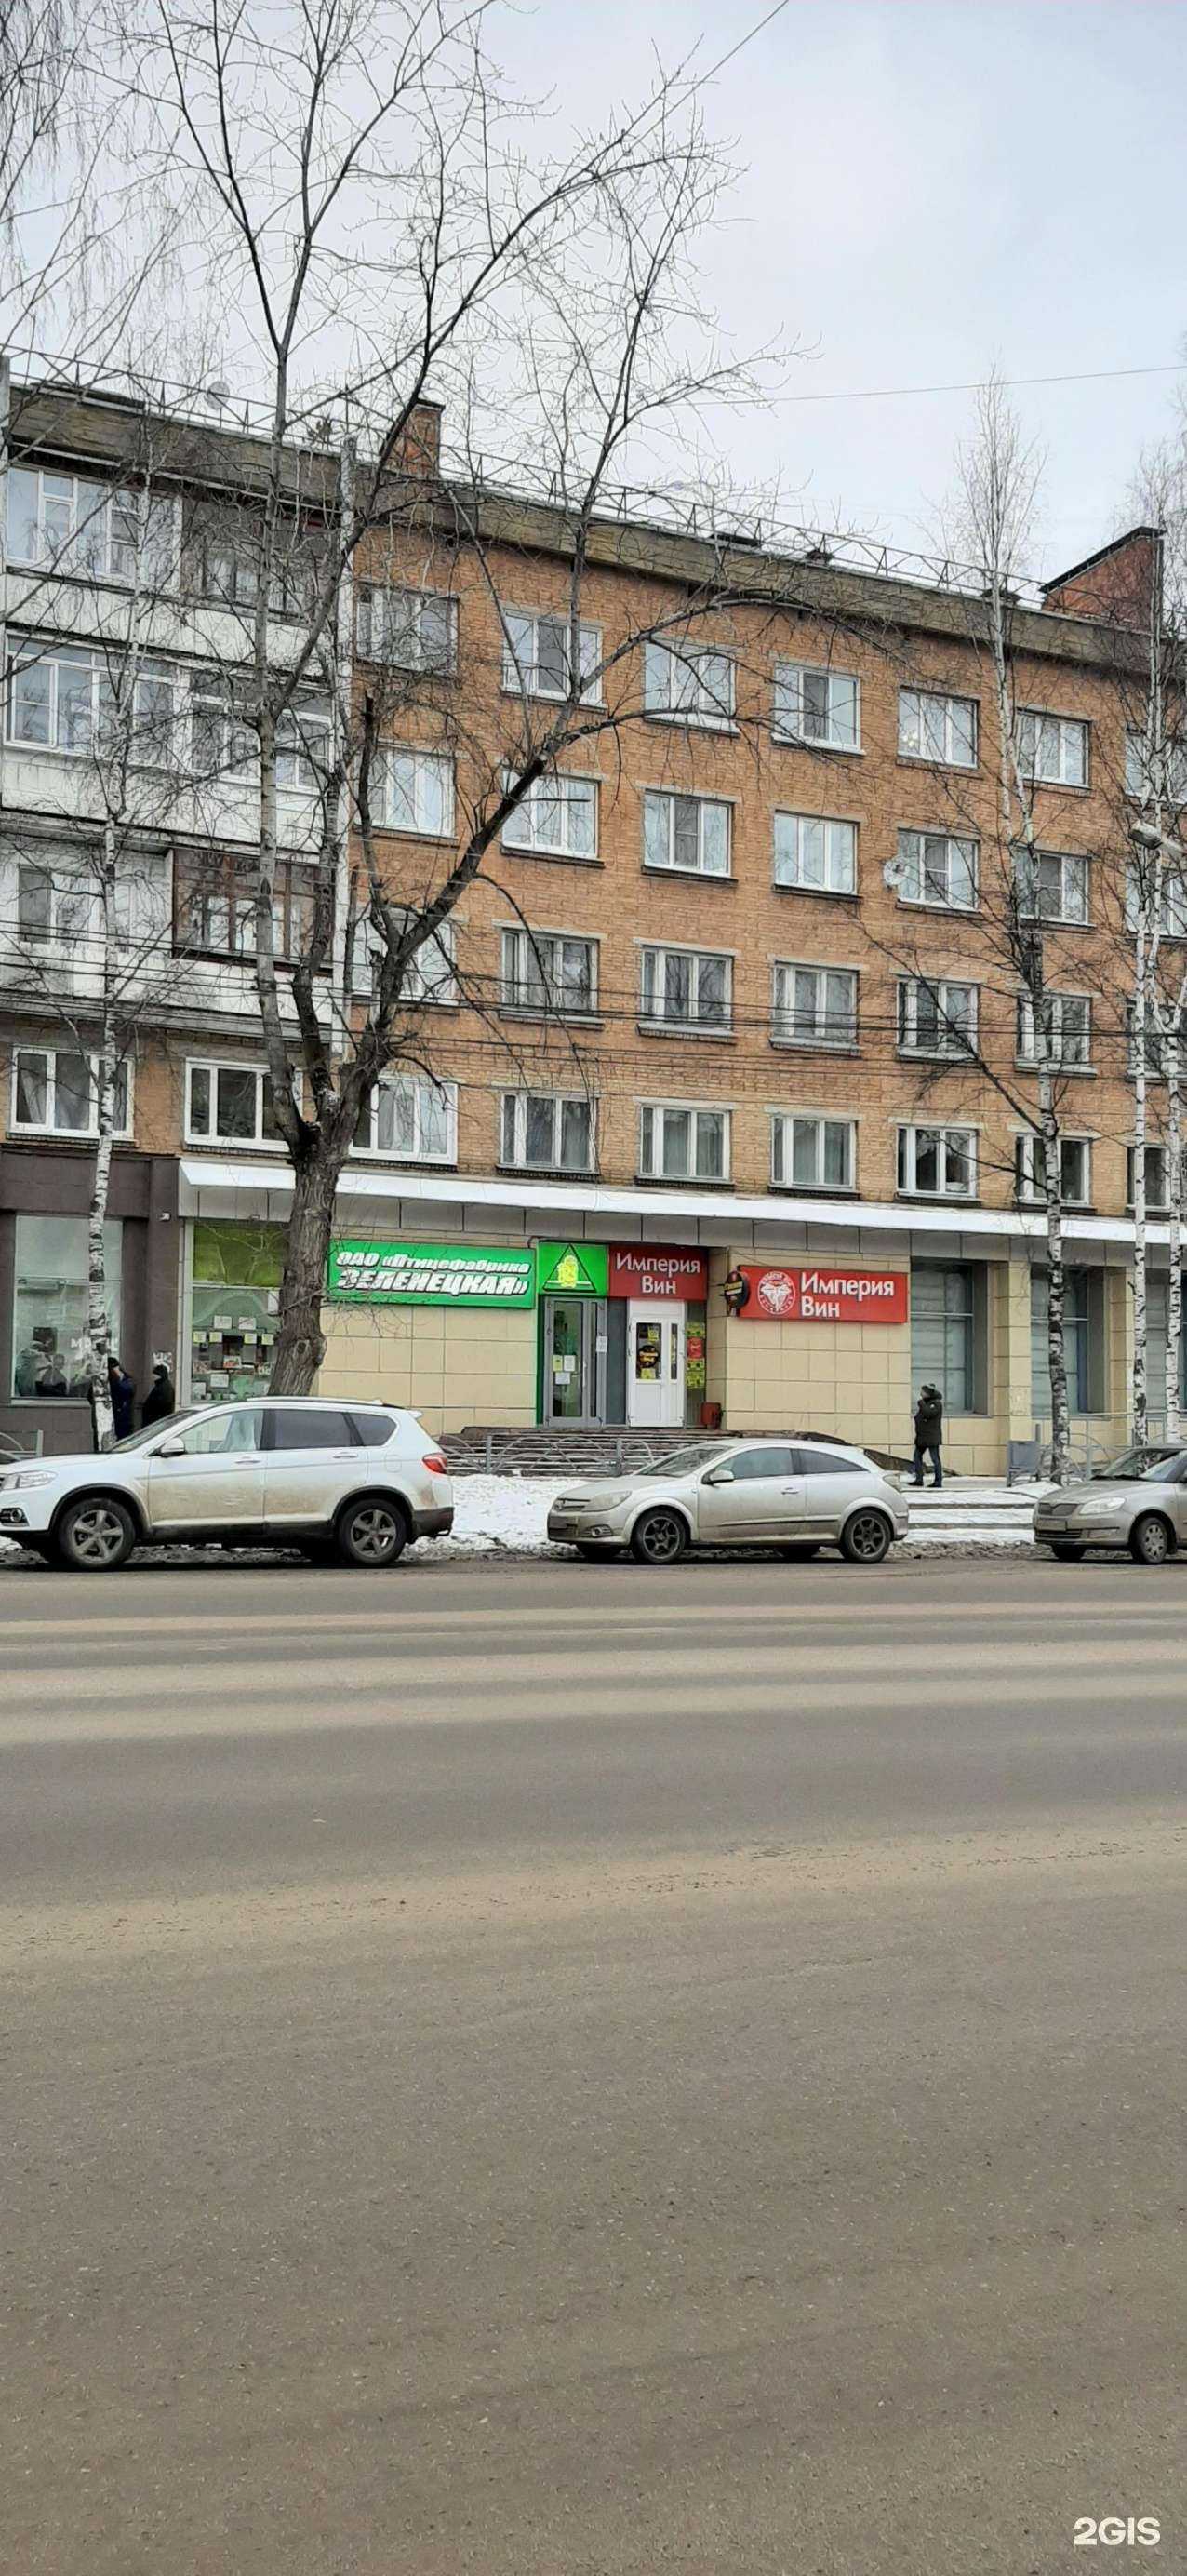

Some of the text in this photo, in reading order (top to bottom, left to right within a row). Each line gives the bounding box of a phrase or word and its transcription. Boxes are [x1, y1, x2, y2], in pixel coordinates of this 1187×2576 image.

[336, 1250, 530, 1273] ОАО «Птицефабрика
[616, 1253, 700, 1278] Империя
[338, 1268, 528, 1296] ЗЕЛЕНЕЦКАЯ»
[642, 1275, 676, 1294] Вин
[801, 1272, 895, 1301] Империя
[801, 1295, 840, 1318] Вин
